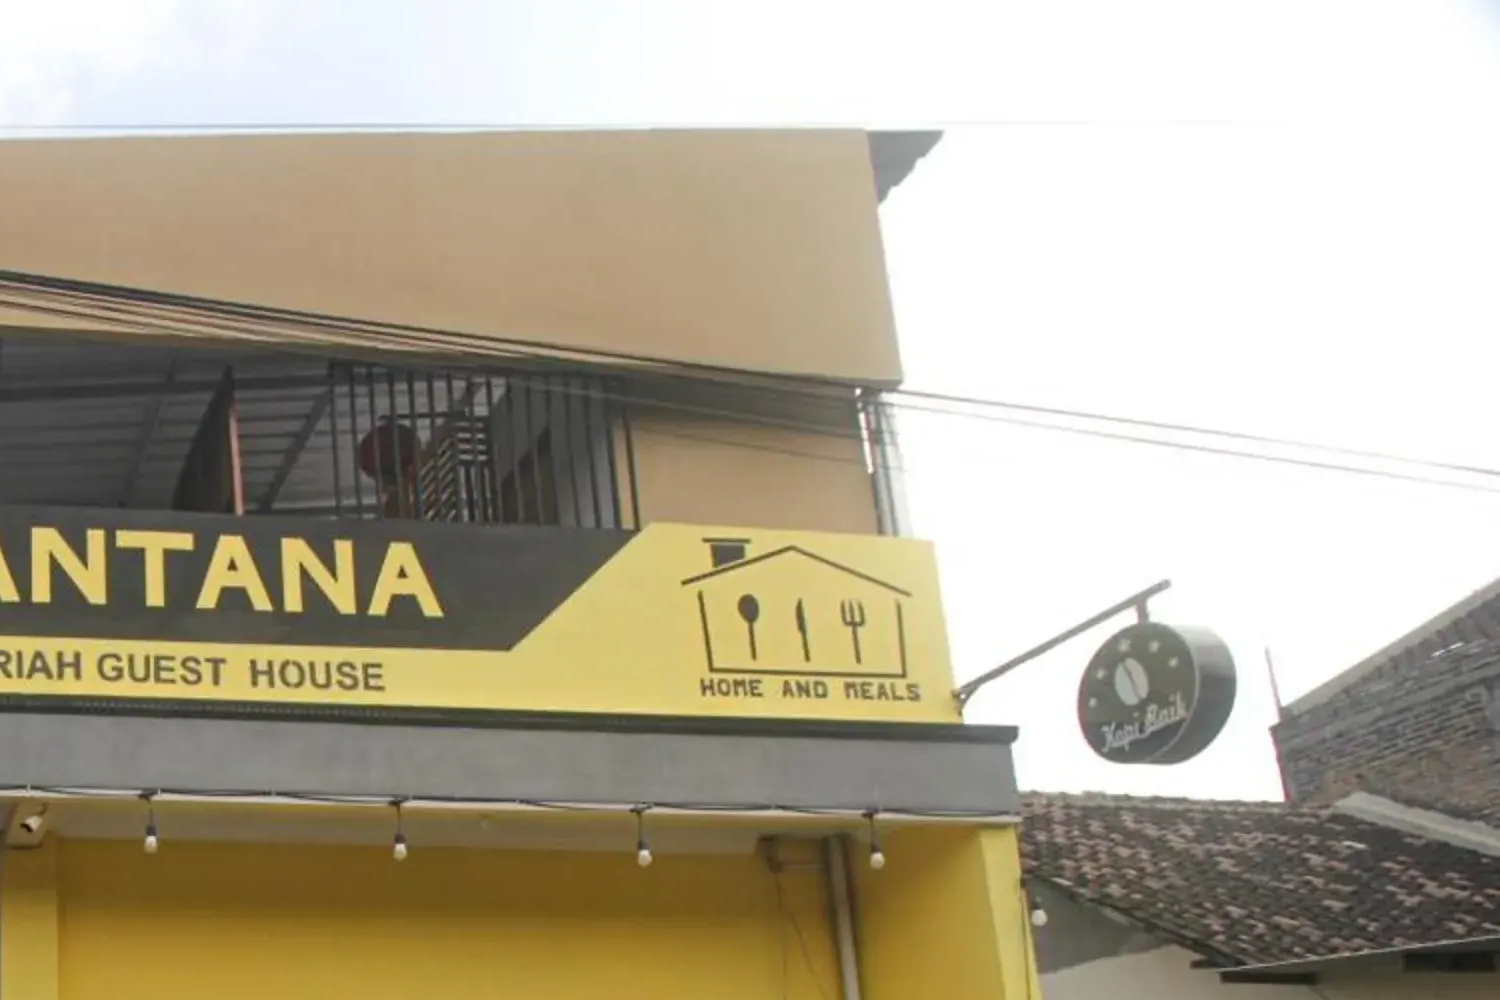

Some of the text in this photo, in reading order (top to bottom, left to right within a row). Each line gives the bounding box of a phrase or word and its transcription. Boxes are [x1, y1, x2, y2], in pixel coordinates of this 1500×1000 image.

[97, 652, 227, 687] GUEST
[249, 659, 386, 691] HOUSE
[699, 678, 921, 701] HOME AND MEALS
